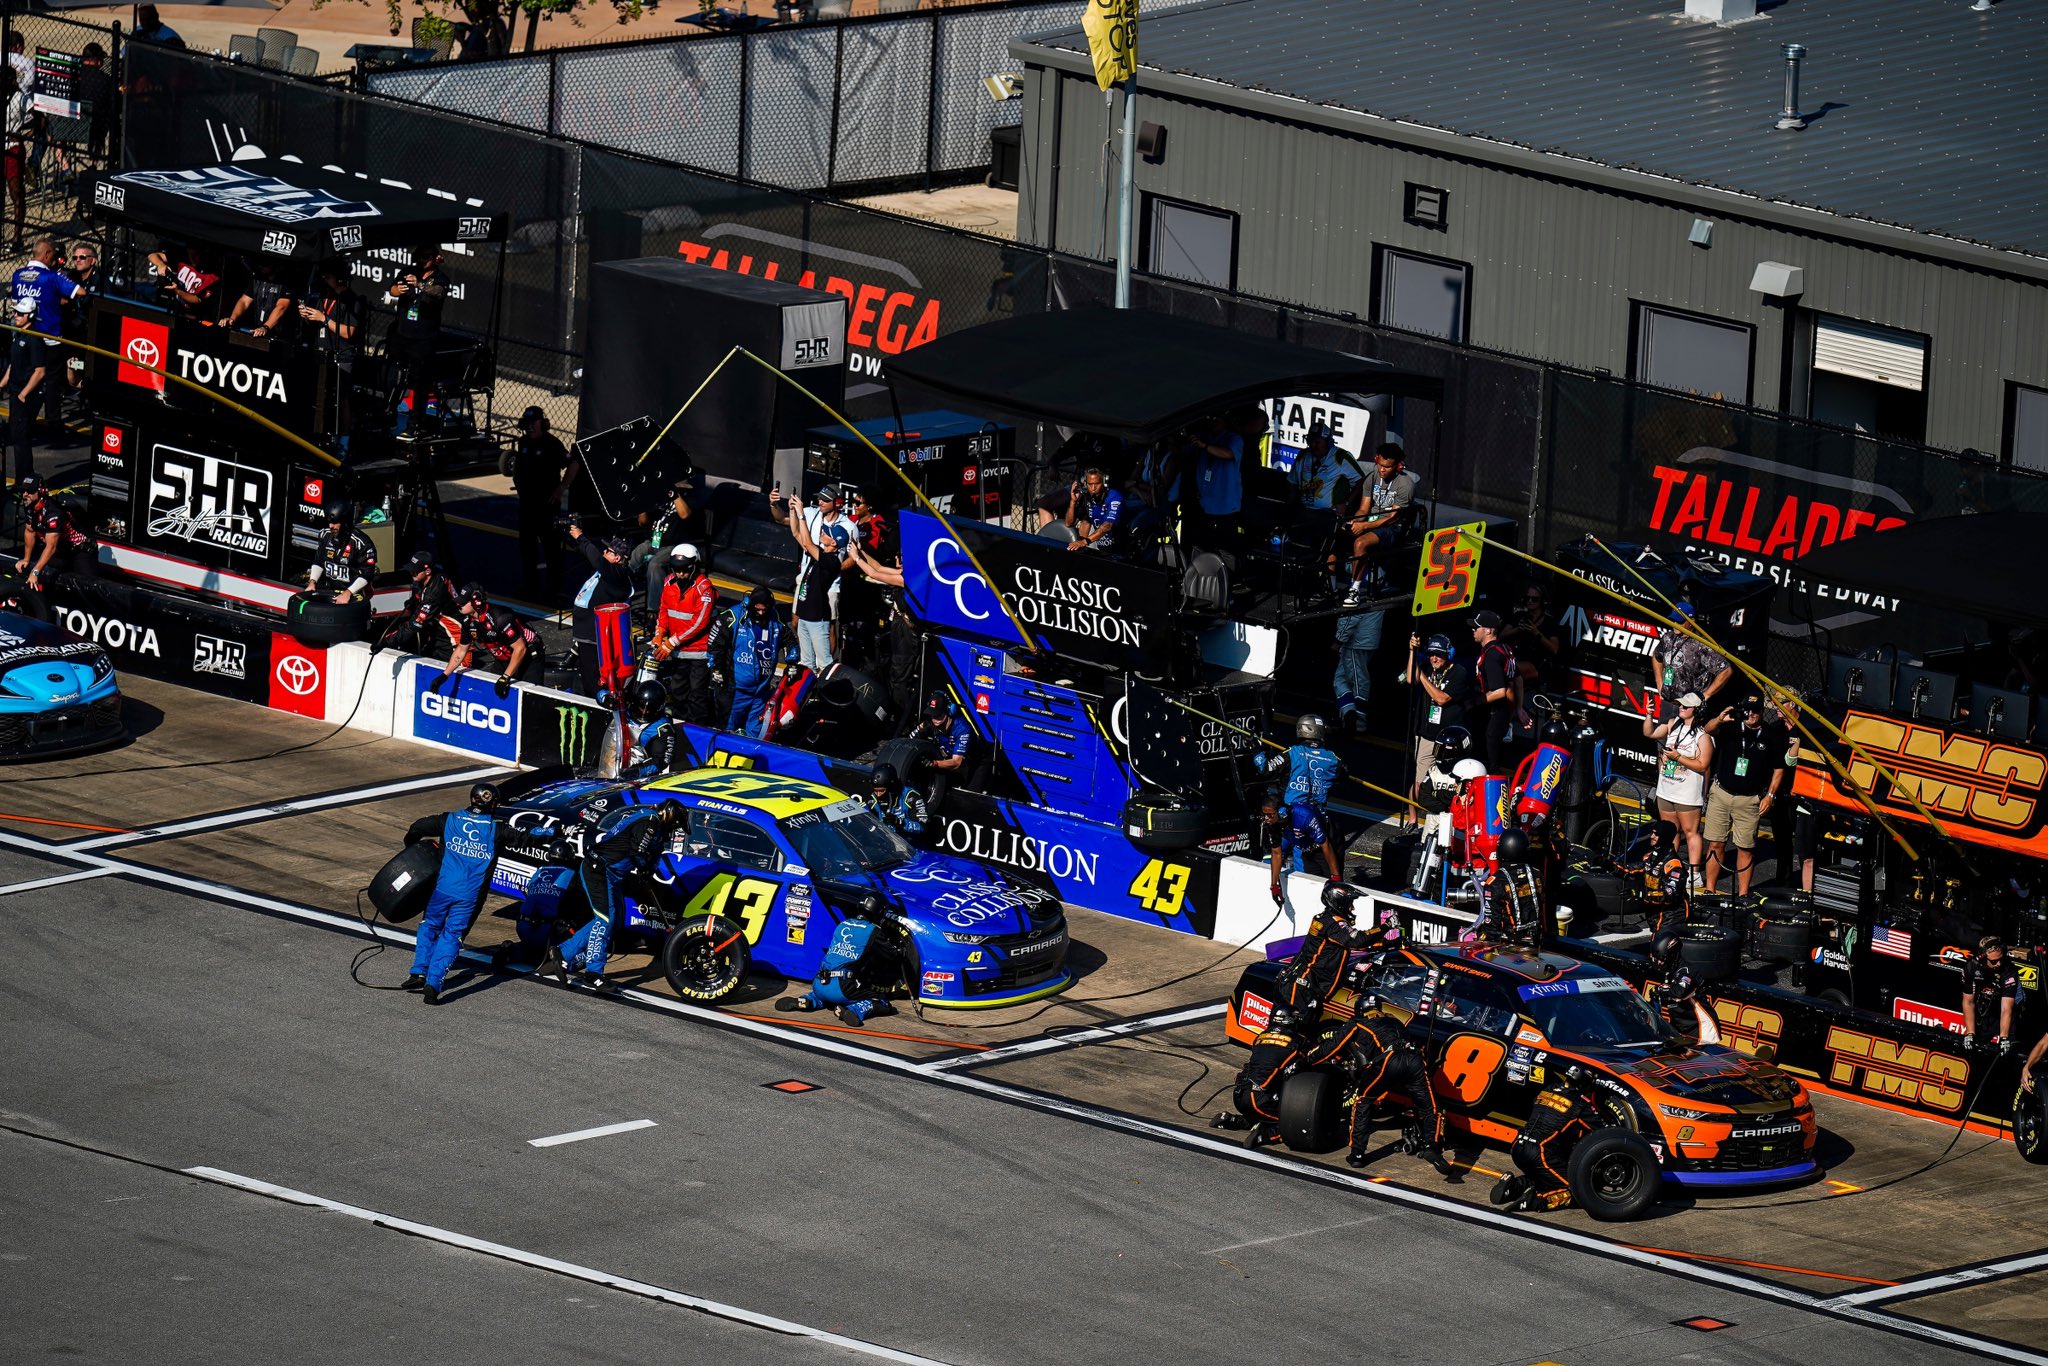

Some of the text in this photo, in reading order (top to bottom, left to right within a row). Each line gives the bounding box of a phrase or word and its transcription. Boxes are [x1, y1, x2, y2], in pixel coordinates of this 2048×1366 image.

[97, 182, 125, 203] SHR
[331, 226, 362, 246] SHR
[459, 217, 491, 234] SHR
[264, 231, 296, 250] SHR
[795, 337, 830, 359] SHR
[177, 348, 288, 403] TOYOTA
[1271, 398, 1345, 437] RAGE
[97, 453, 124, 468] TOYOTA
[298, 503, 326, 518] TOYOTA
[212, 528, 267, 553] RACING
[1014, 565, 1122, 614] CLASSIC
[1000, 592, 1142, 648] COLLISION
[55, 606, 161, 658] TOYOTA
[196, 636, 246, 669] SHR
[49, 692, 81, 704] Supra
[420, 690, 511, 734] GEICO
[1616, 747, 1658, 765] PRIME
[1539, 752, 1564, 801] SUNOCO
[697, 799, 748, 816] RYAN ELLIS
[837, 804, 856, 814] ELLIS
[785, 812, 821, 829] xfinity
[445, 841, 492, 860] COLLISION
[452, 836, 488, 852] CLASSIC
[936, 818, 1100, 886] OLLISION
[932, 881, 1020, 911] CLASSIC
[1129, 858, 1192, 916] 43
[682, 872, 779, 945] 43
[585, 921, 601, 963] COLLISION
[592, 925, 606, 959] CLASSIC
[1412, 918, 1448, 945] NEW!
[1010, 935, 1064, 957] CAMARO
[967, 951, 983, 964] 43
[925, 971, 954, 980] ARP
[1442, 961, 1494, 979] SAMMY SMITH
[682, 976, 739, 1000] GOODYEAR
[1528, 982, 1570, 997] xfinity
[1592, 980, 1622, 988] SMITH
[1534, 1051, 1548, 1063] 12
[1433, 1035, 1506, 1103] 8
[1677, 1126, 1694, 1140] 8
[1732, 1124, 1802, 1138] CAMARO
